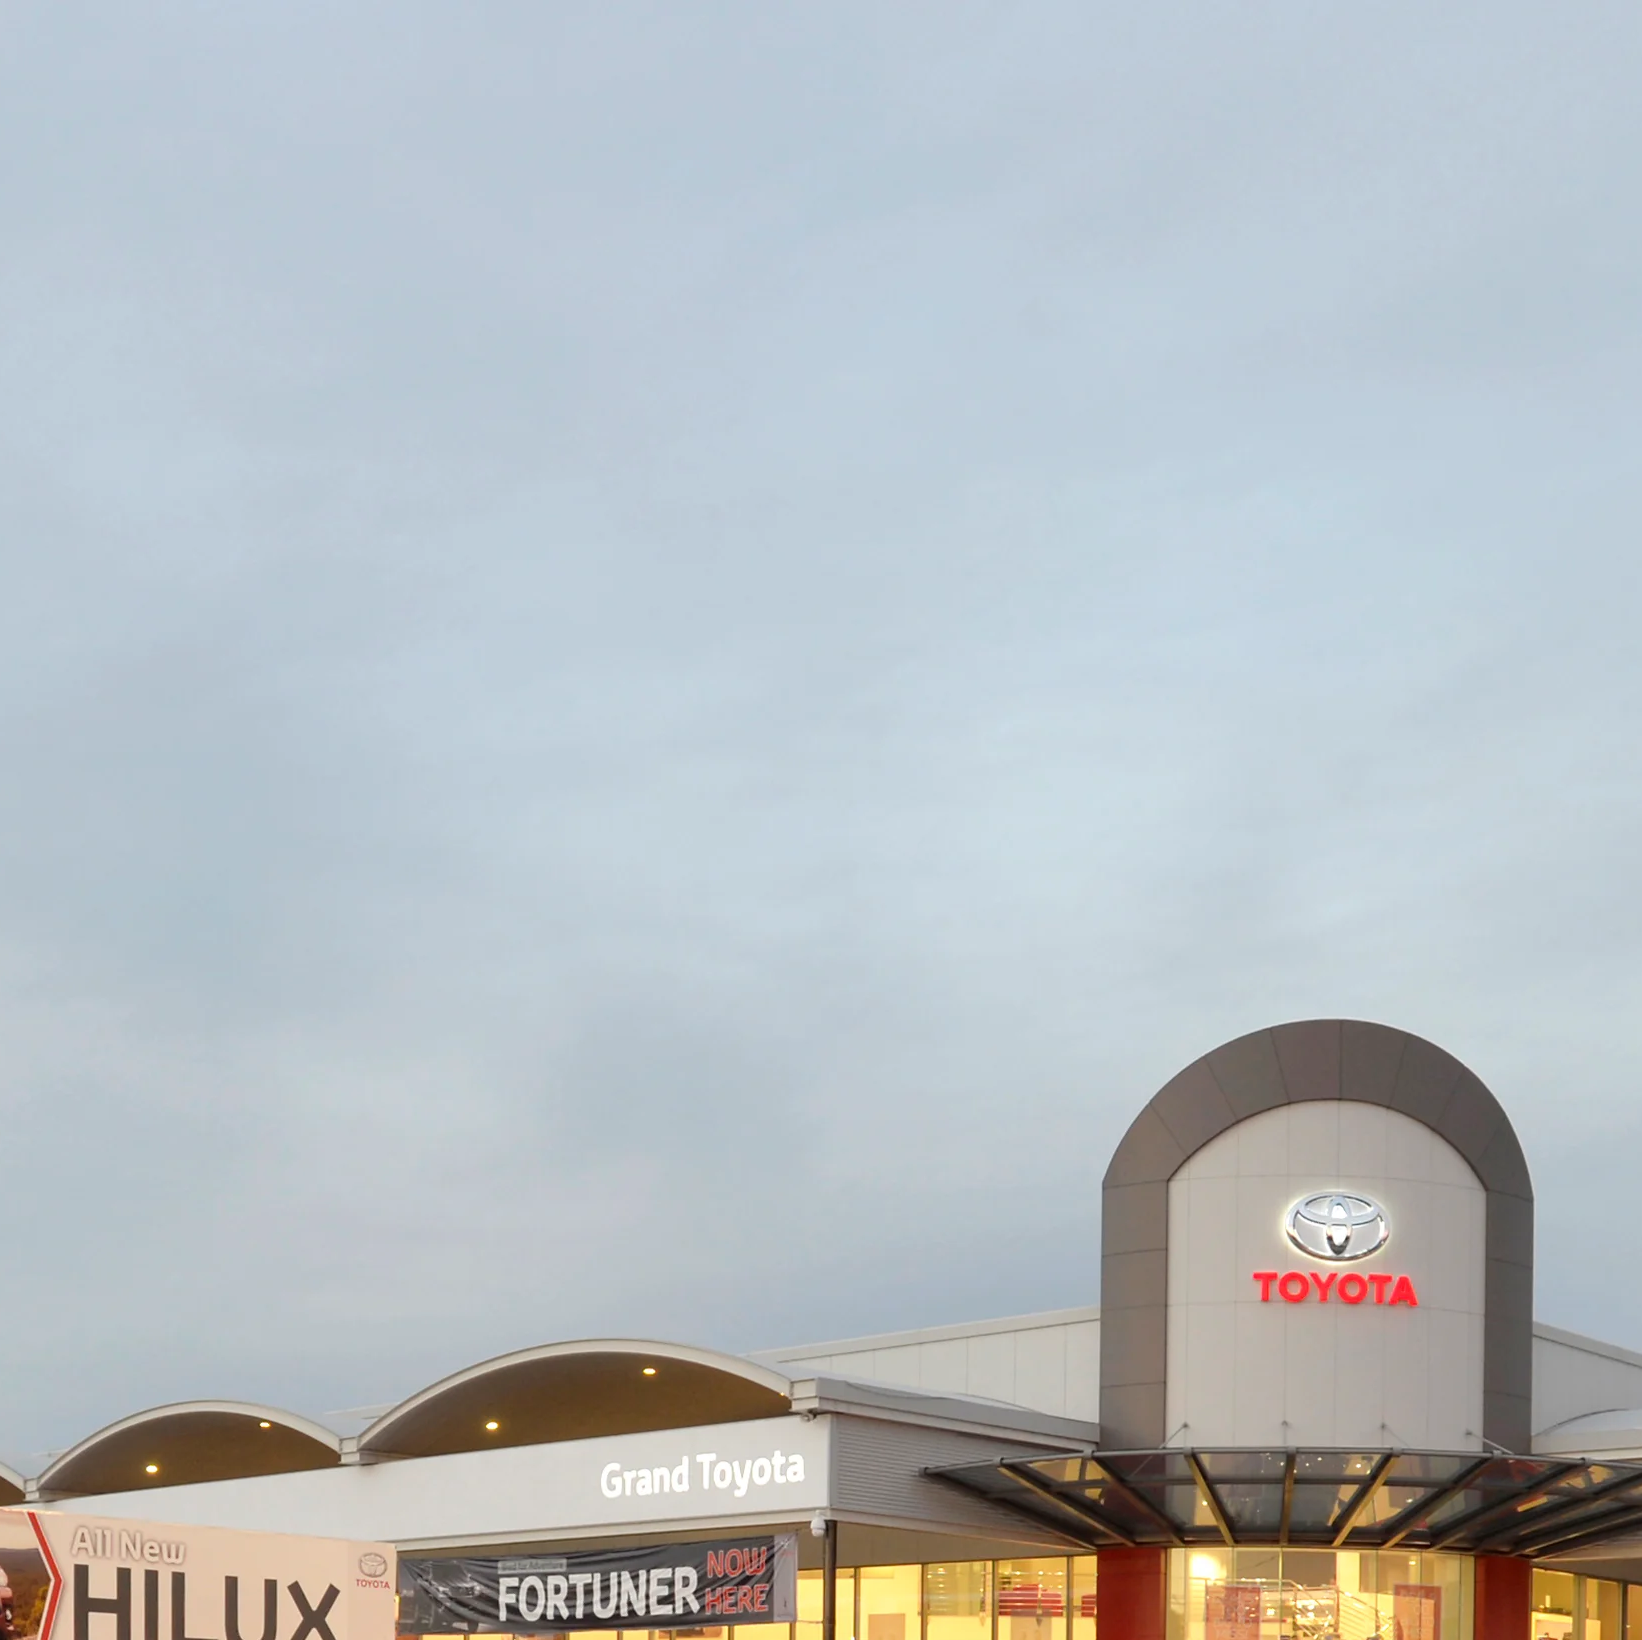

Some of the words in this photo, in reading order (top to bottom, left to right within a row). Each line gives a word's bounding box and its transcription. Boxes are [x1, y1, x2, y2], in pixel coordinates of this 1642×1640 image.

[1252, 1271, 1419, 1307] TOYOTA
[600, 1462, 690, 1498] Grand
[695, 1450, 806, 1497] Toyota
[70, 1526, 113, 1558] All
[119, 1529, 187, 1566] New
[707, 1546, 768, 1579] NOW
[356, 1578, 391, 1590] TOYOTA
[498, 1566, 701, 1622] FORTUNER
[706, 1583, 769, 1615] HERE
